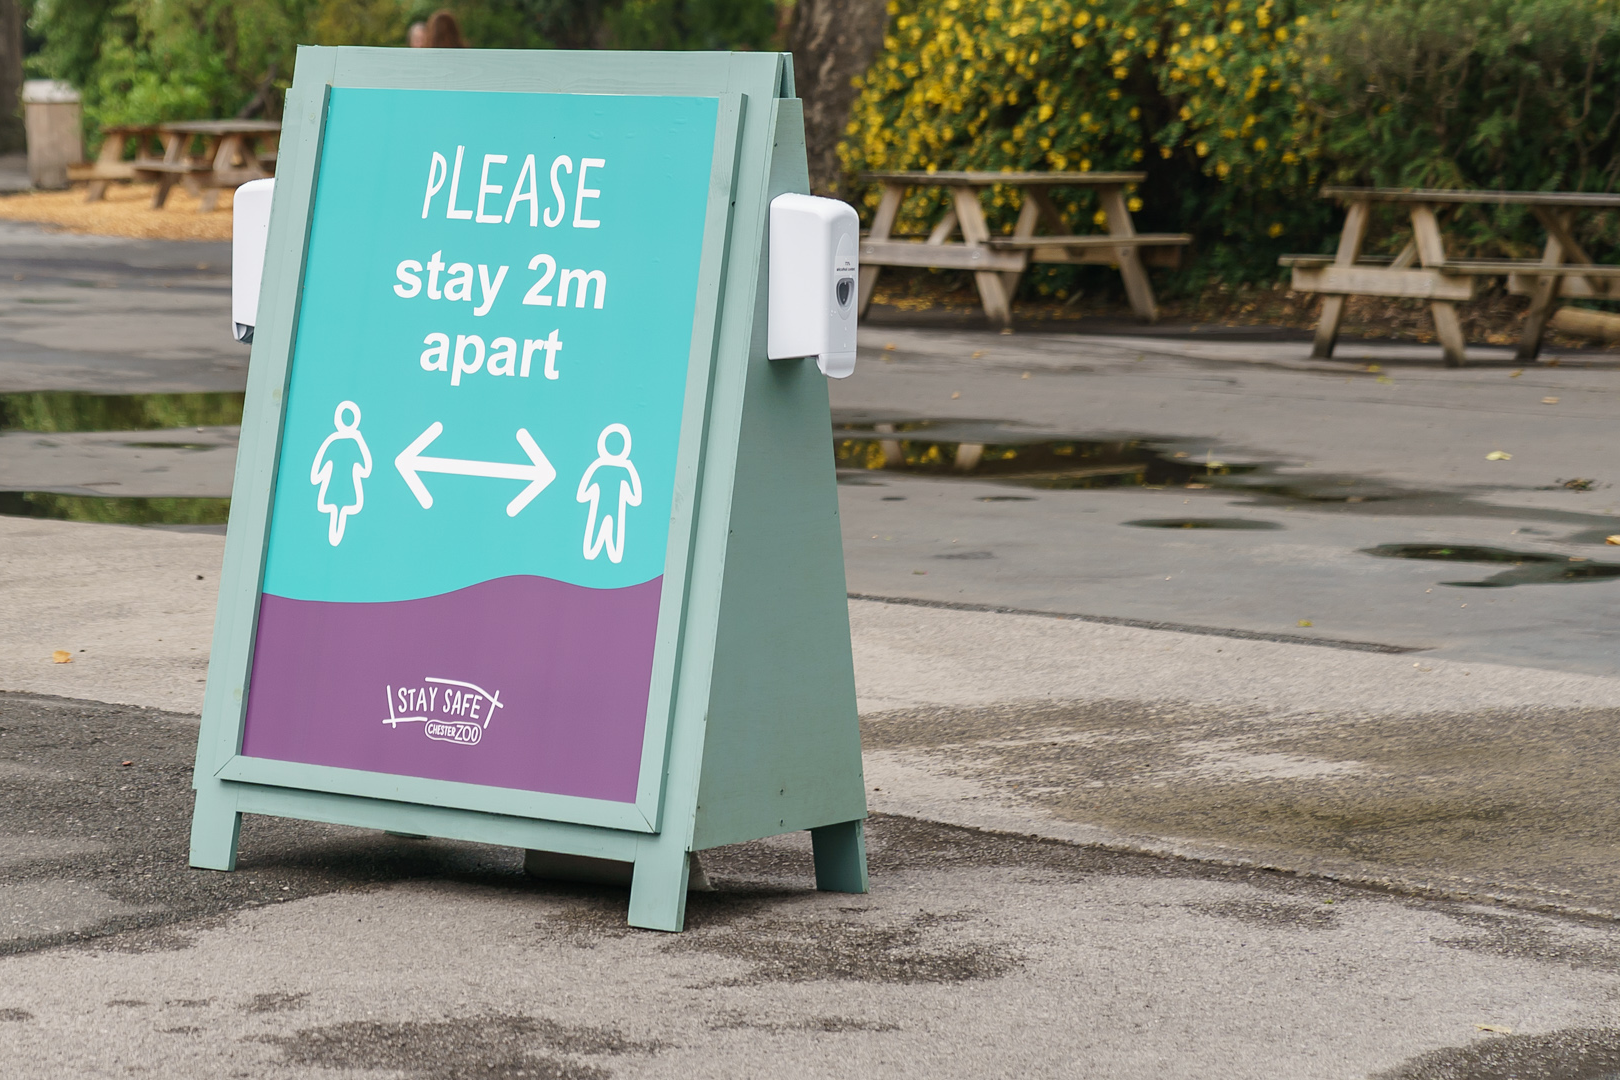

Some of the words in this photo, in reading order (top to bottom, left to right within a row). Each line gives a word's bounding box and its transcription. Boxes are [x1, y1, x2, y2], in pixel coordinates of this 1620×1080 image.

[421, 144, 606, 229] PLEASE
[392, 249, 510, 317] stay
[522, 253, 607, 310] 2m
[419, 328, 563, 387] apart
[397, 686, 438, 713] STAY
[442, 689, 483, 719] SAFE
